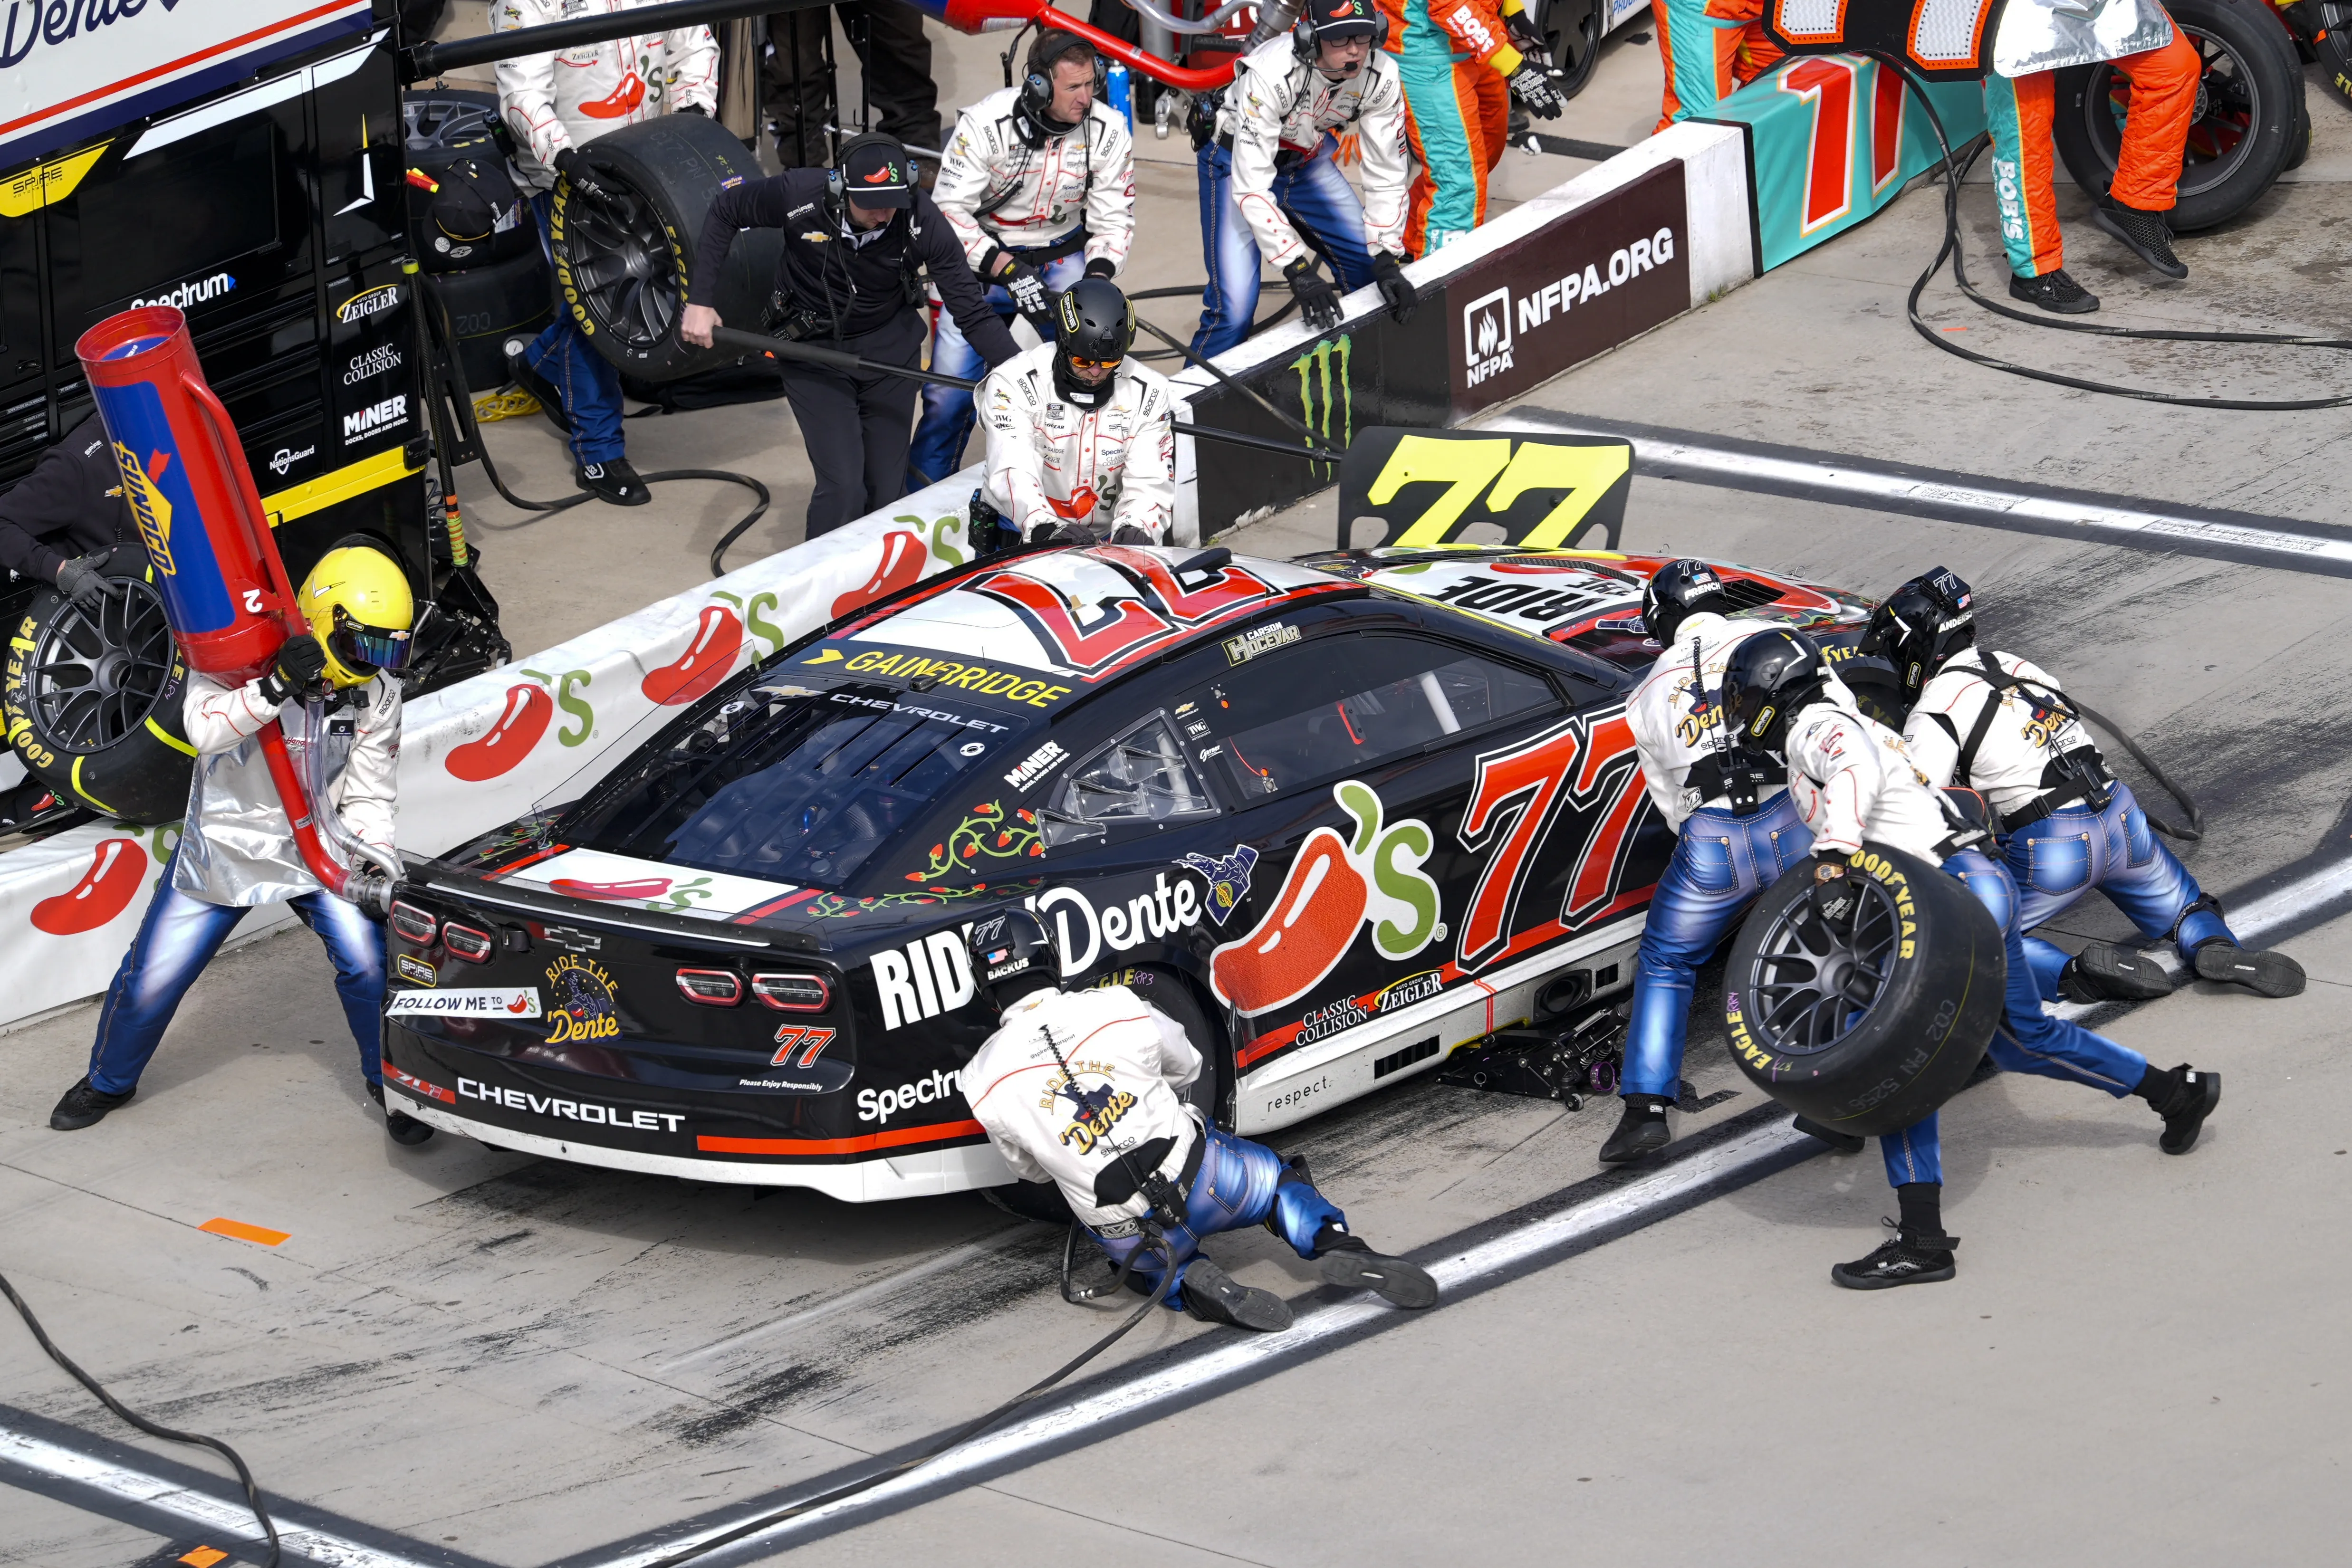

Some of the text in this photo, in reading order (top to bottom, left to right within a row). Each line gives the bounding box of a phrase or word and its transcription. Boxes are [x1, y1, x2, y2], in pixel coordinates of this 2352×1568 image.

[572, 50, 599, 60] ZEIGLER
[983, 126, 999, 154] sparco
[1101, 129, 1118, 157] sparco
[13, 167, 62, 194] SPIRE
[787, 202, 815, 218] SPIRE
[1997, 160, 2023, 240] BOB'S
[368, 291, 382, 299] GROUP
[1518, 227, 1674, 334] NFPA.ORG
[342, 287, 398, 324] ZEIGLER
[344, 353, 402, 385] COLLISION
[350, 343, 394, 370] CLASSIC
[1467, 352, 1514, 389] NFPA
[1017, 378, 1037, 406] sparco
[1143, 388, 1160, 417] sparco
[344, 395, 407, 437] MINER
[345, 417, 409, 446] DOCKS, DOORS AND MORE.
[269, 445, 315, 470] NationsGuard
[1368, 435, 1629, 548] 77
[1684, 582, 1721, 600] FRENCH
[1933, 571, 1957, 595] 77
[1247, 621, 1283, 640] CARSON
[1938, 611, 1973, 633] ANDERSO
[1230, 625, 1302, 662] HOCEVAR
[845, 650, 1072, 708] GAINBRIDGE
[379, 689, 396, 715] sparco
[830, 693, 1009, 734] CHEVROLET
[1177, 708, 1199, 720] CHEVROLET
[1200, 745, 1220, 762] Garner
[1701, 733, 1735, 751] sparo
[1003, 740, 1065, 789] MINER
[1019, 752, 1071, 793] DOCKS, DOORS AND MORE.
[1850, 849, 1916, 960] OODYEAR
[975, 915, 1005, 946] 77
[401, 959, 433, 979] SPIRE
[546, 954, 618, 996] RIDE THE
[869, 922, 975, 1032] RID
[988, 957, 1029, 981] BACKUS
[1396, 977, 1424, 990] AUTO GROUP
[394, 997, 461, 1010] FOLLOW
[465, 997, 486, 1011] ME
[492, 996, 502, 1004] TO
[1379, 973, 1443, 1012] ZEIGLER
[1303, 994, 1357, 1026] CLASSIC
[1295, 1006, 1368, 1046] COLLISION
[1726, 1010, 1773, 1070] EAGLE
[770, 1024, 835, 1069] 77
[1030, 1033, 1075, 1059] @spiremtorsport
[739, 1078, 823, 1092] Please Enjoy Responsibly
[1075, 1060, 1115, 1081] THE
[457, 1077, 686, 1132] CHEVROLET
[857, 1069, 963, 1124] Spectru
[1267, 1074, 1333, 1113] respect.
[1100, 1136, 1136, 1158] sparco
